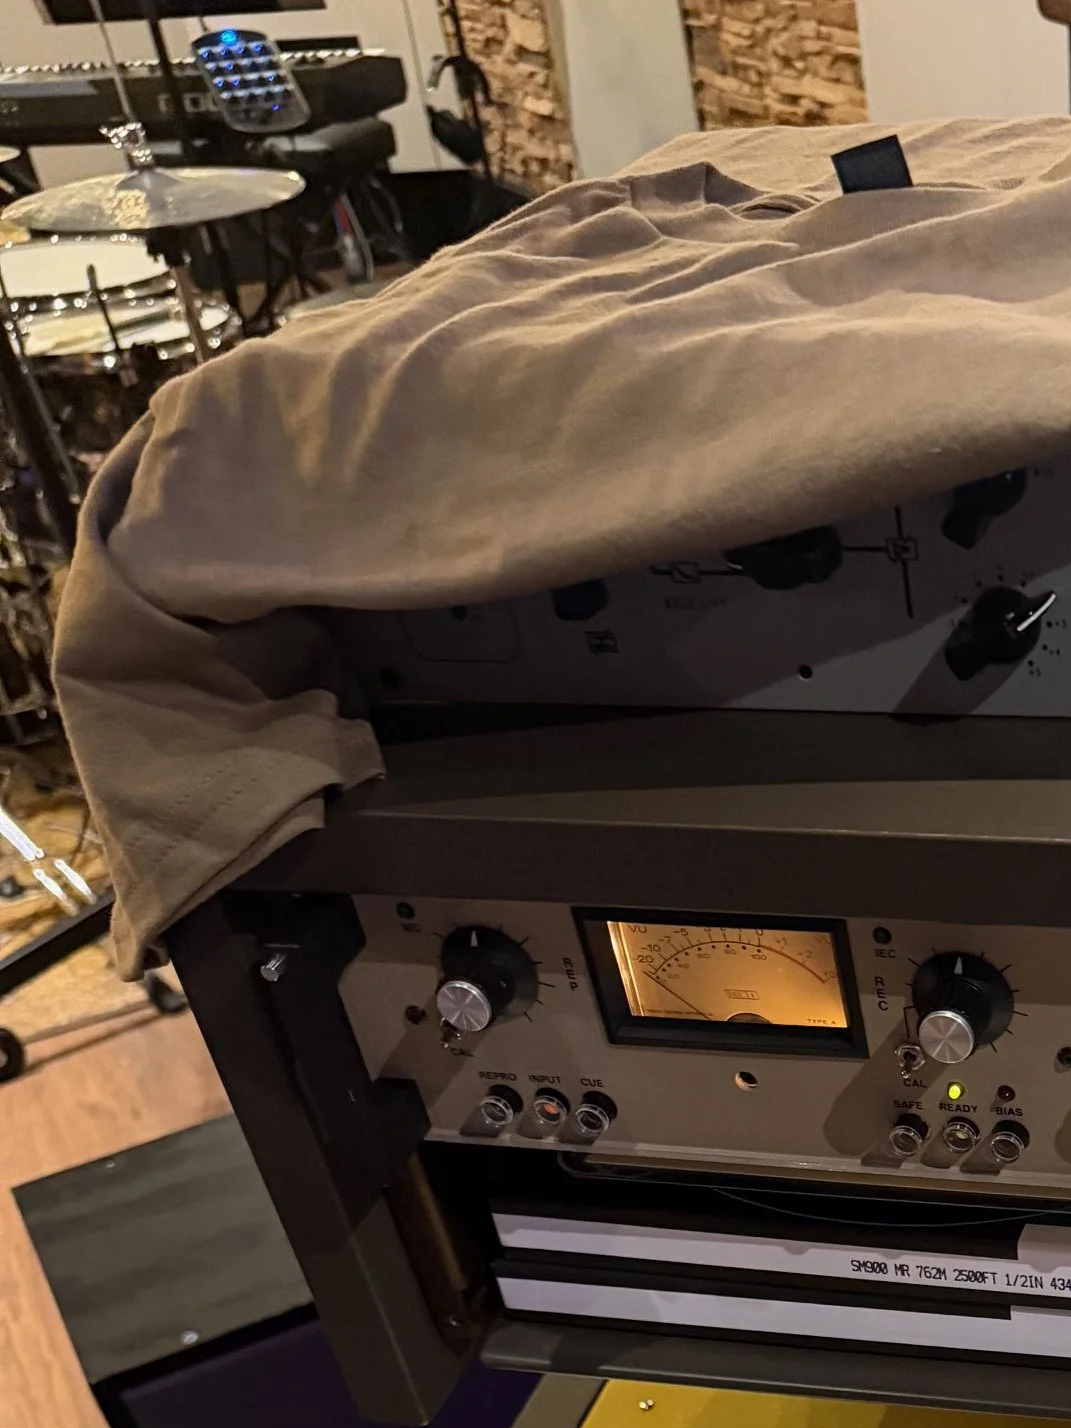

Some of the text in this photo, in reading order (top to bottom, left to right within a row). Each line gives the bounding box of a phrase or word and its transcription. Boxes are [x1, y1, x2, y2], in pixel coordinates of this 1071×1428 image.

[627, 925, 647, 934] VU
[641, 944, 660, 952] -10
[875, 950, 896, 958] IEC
[562, 957, 578, 991] REP
[874, 976, 888, 1011] REC
[452, 1048, 474, 1057] CAL
[478, 1071, 517, 1081] REPRO
[528, 1075, 561, 1084] INPUT
[580, 1078, 604, 1088] CUE
[903, 1078, 927, 1088] CAL
[894, 1100, 923, 1110] SAFE
[939, 1103, 978, 1113] READY
[996, 1107, 1023, 1117] BIAS
[850, 1259, 888, 1275] SM900
[894, 1263, 910, 1277] MR
[915, 1265, 947, 1281] 762M
[953, 1268, 998, 1285] 2500FT
[1004, 1273, 1043, 1289] 1/2IN
